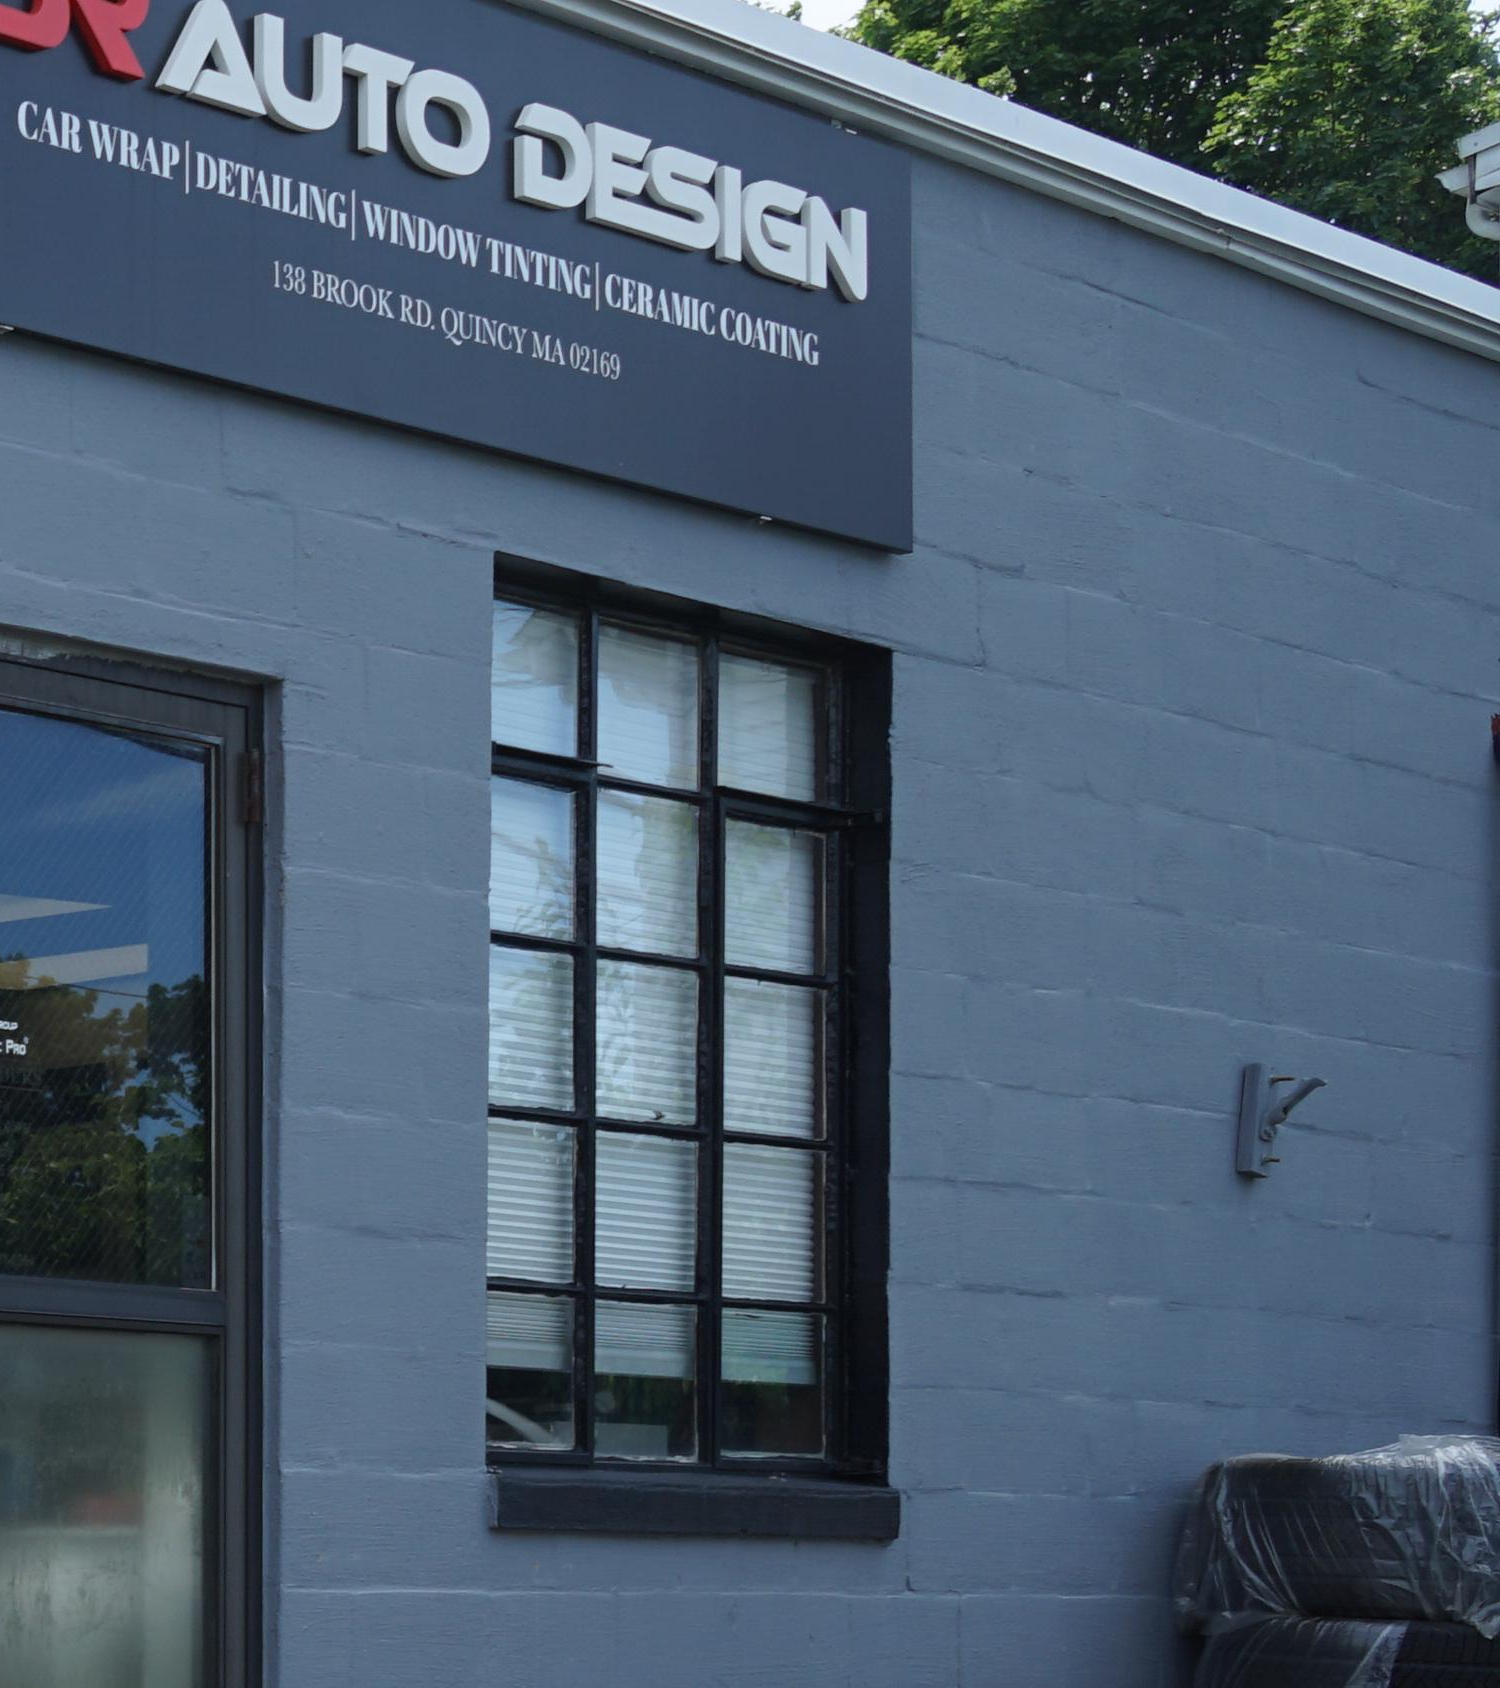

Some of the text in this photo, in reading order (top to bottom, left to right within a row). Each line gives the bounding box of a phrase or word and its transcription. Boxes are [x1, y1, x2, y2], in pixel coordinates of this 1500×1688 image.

[17, 100, 820, 366] CAR WRAP DETAILING WINDOW TINTING CERAMIC COATING
[155, 0, 491, 179] AUTO
[513, 102, 869, 303] DESIGN
[272, 259, 622, 381] 138 BROOK RD. QUINCY MA 02169
